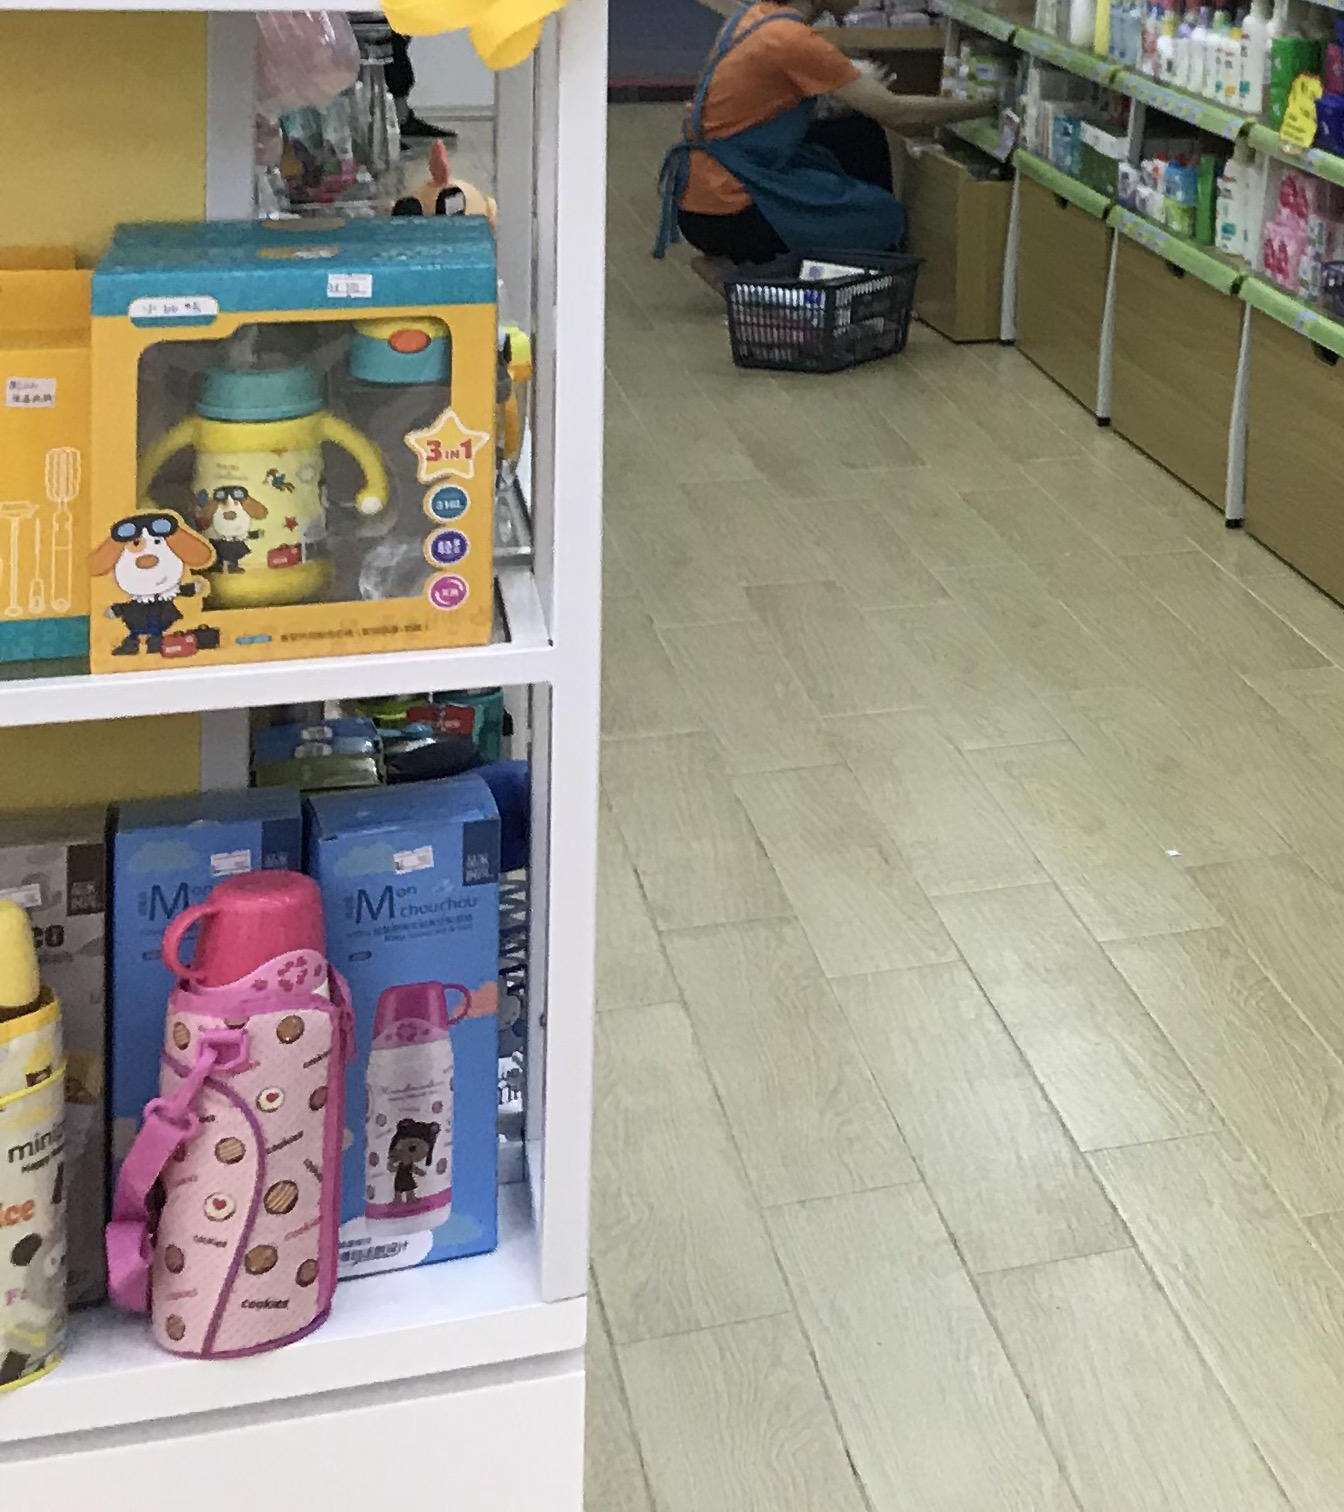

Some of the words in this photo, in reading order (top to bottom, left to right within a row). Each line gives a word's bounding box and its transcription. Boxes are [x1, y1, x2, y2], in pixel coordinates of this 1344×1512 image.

[426, 440, 442, 462] 3
[444, 447, 460, 460] IN
[460, 439, 473, 460] 1
[400, 896, 478, 919] chouchou
[241, 1299, 290, 1309] cookies
